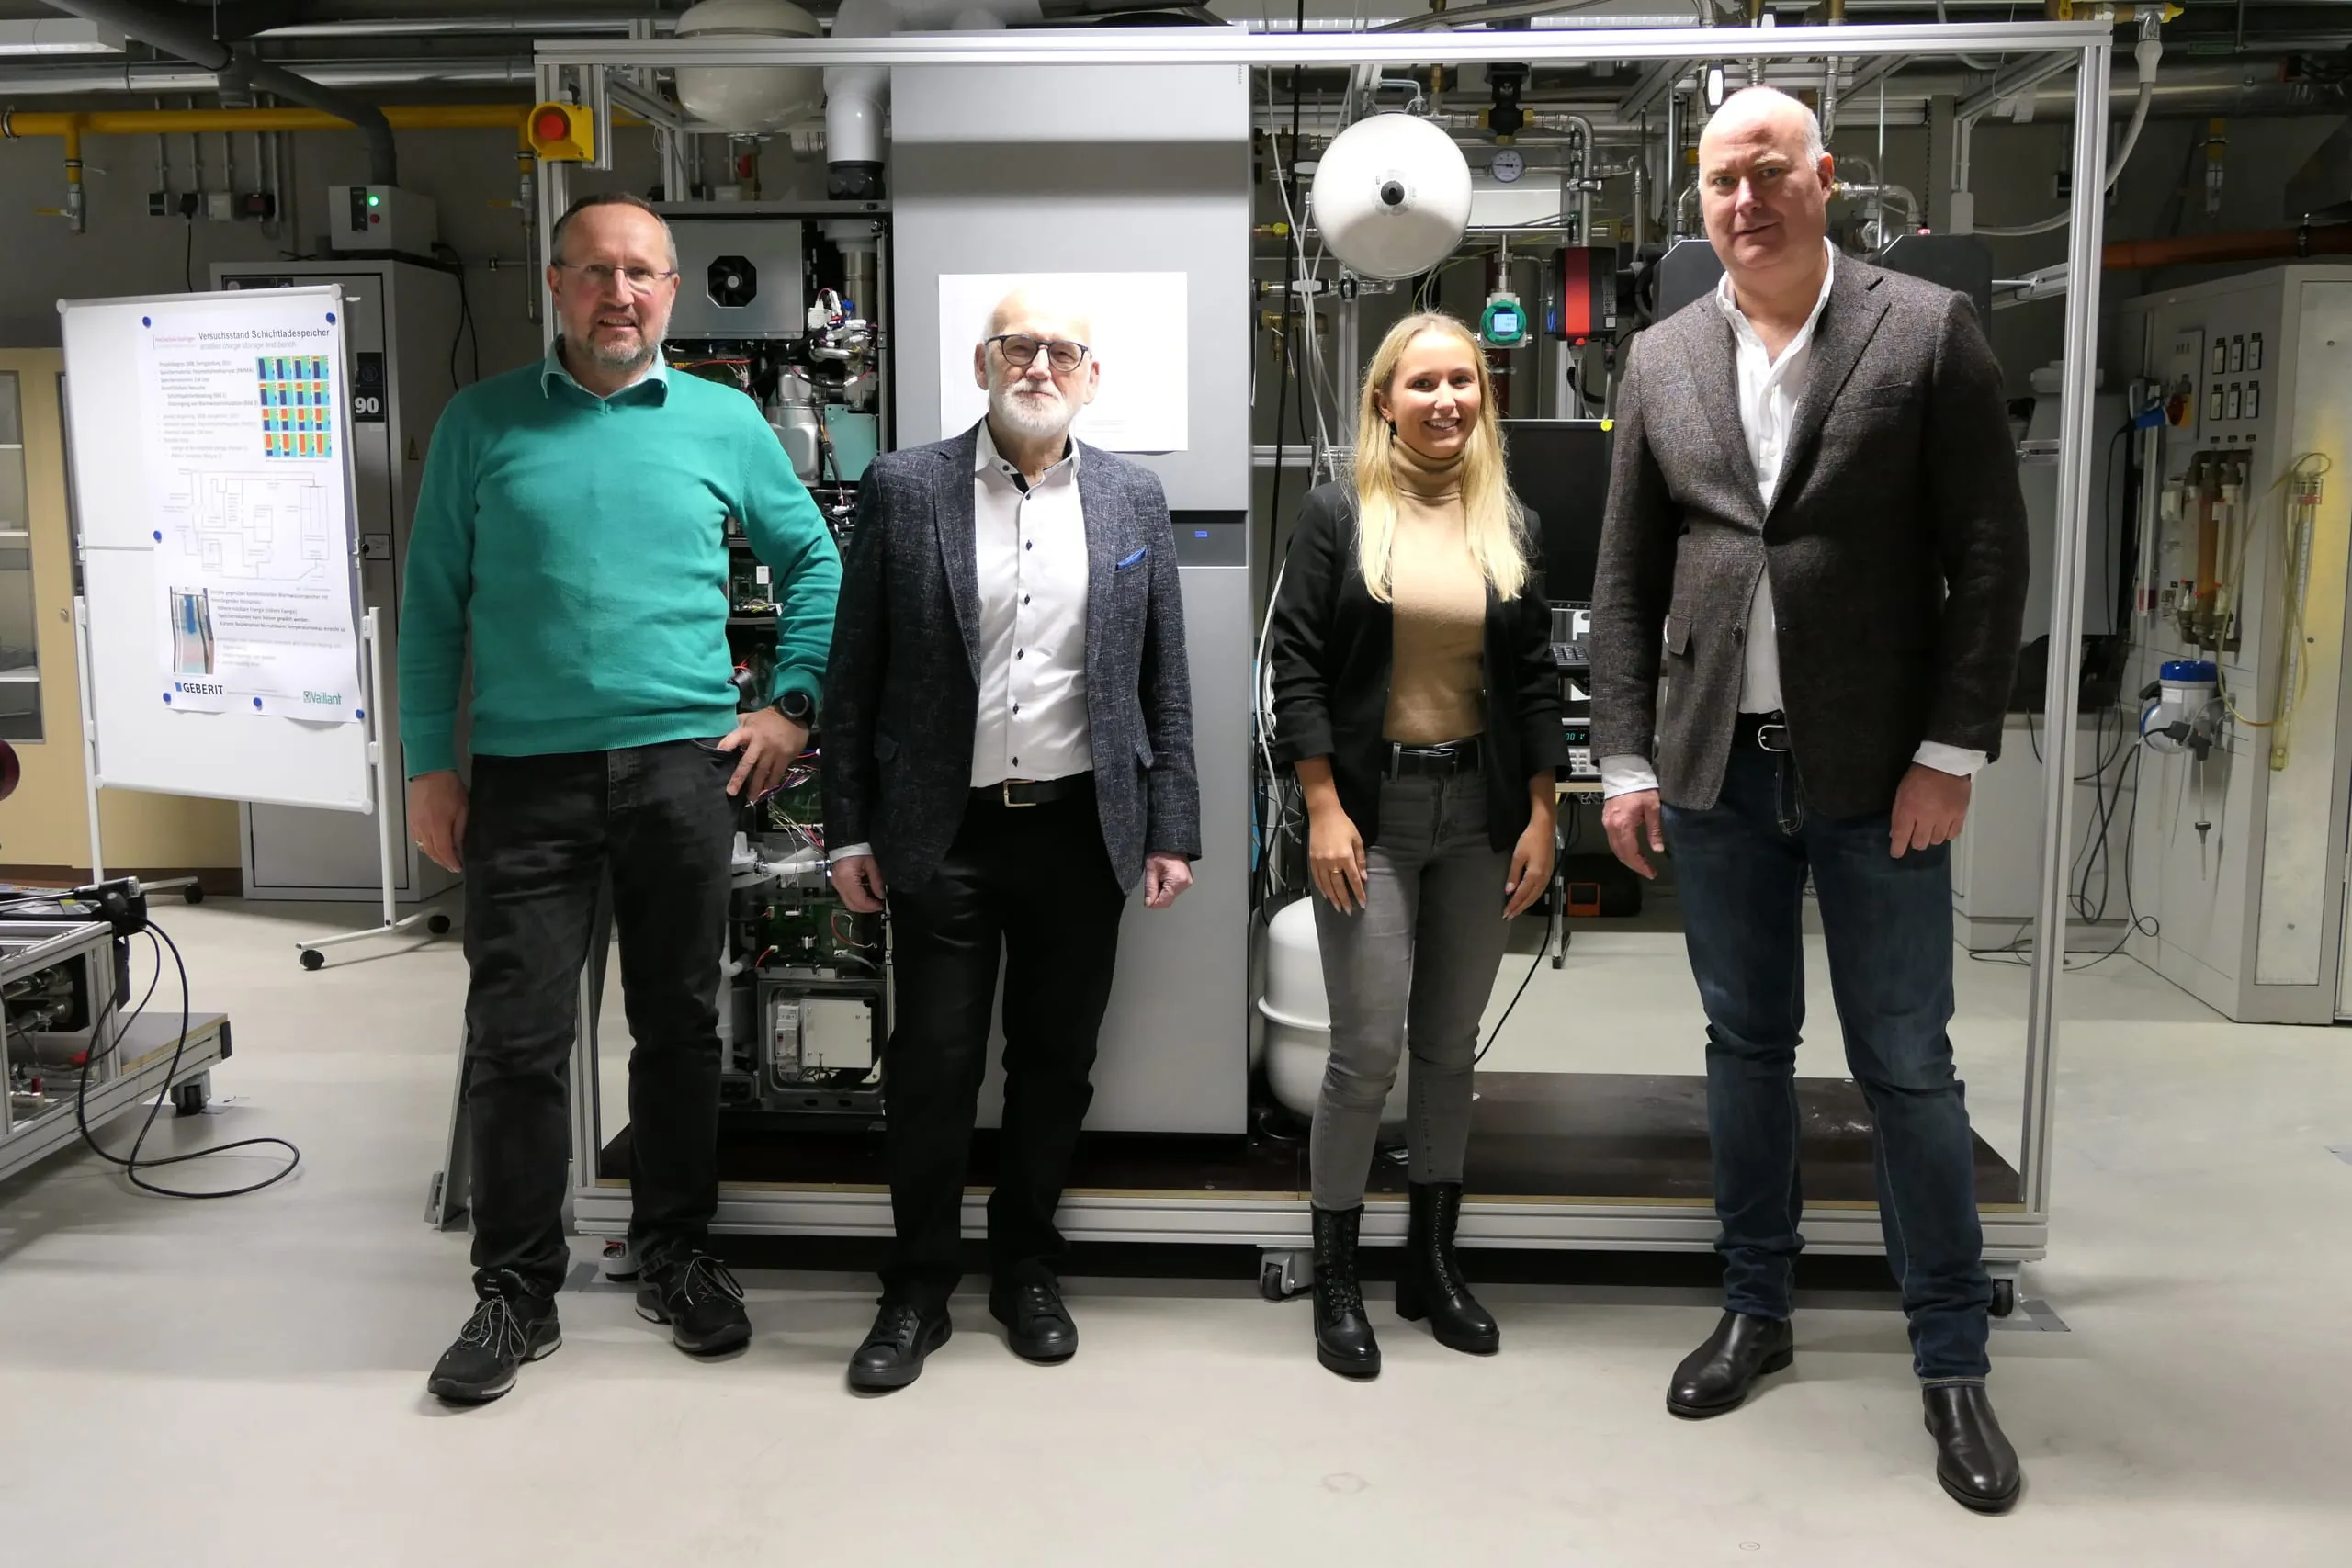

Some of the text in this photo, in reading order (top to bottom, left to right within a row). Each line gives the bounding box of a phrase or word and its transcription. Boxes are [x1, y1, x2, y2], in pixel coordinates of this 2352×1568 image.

[198, 330, 250, 342] Versuchsstand
[252, 327, 331, 340] Schichtladespeicher
[355, 396, 379, 414] 90
[183, 682, 223, 695] GEBERIT
[311, 691, 342, 705] Vaillant
